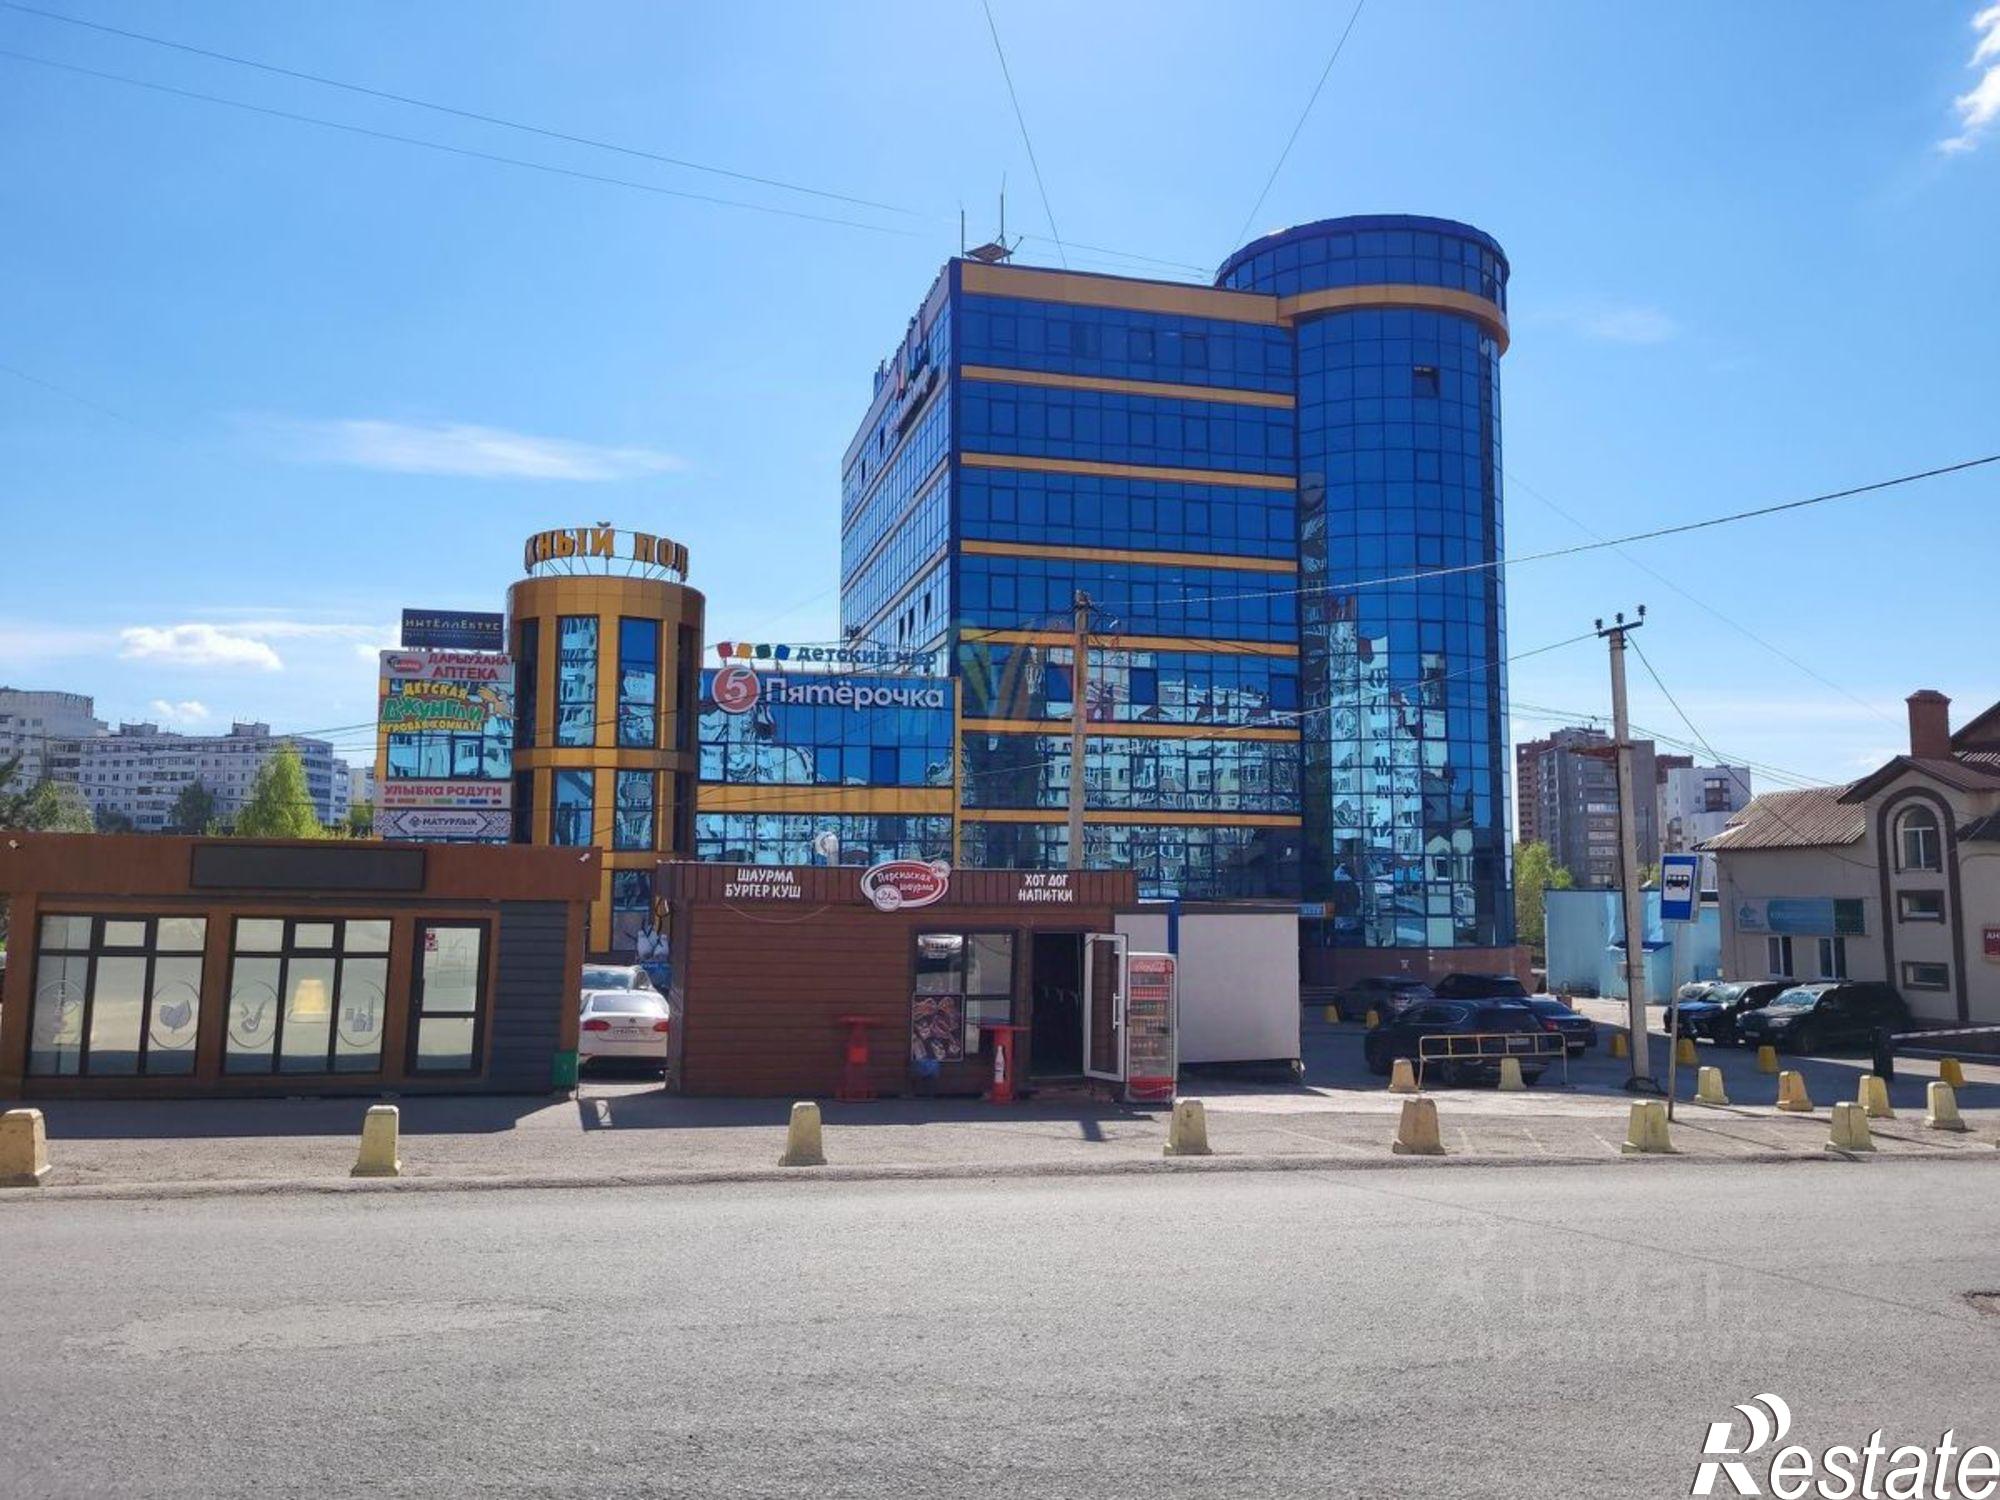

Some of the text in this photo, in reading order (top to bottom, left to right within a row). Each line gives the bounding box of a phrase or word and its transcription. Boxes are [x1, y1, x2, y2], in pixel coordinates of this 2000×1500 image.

[432, 666, 499, 681] АПТЕКА
[403, 682, 468, 700] ДЕТСКАЯ
[765, 677, 945, 712] Пятёрочка
[737, 867, 795, 884] ШАУРМА
[1024, 873, 1070, 887] ХОТ ДОГ
[725, 883, 802, 899] БУРГЕР КУШ
[1018, 888, 1073, 902] НАПИТКИ
